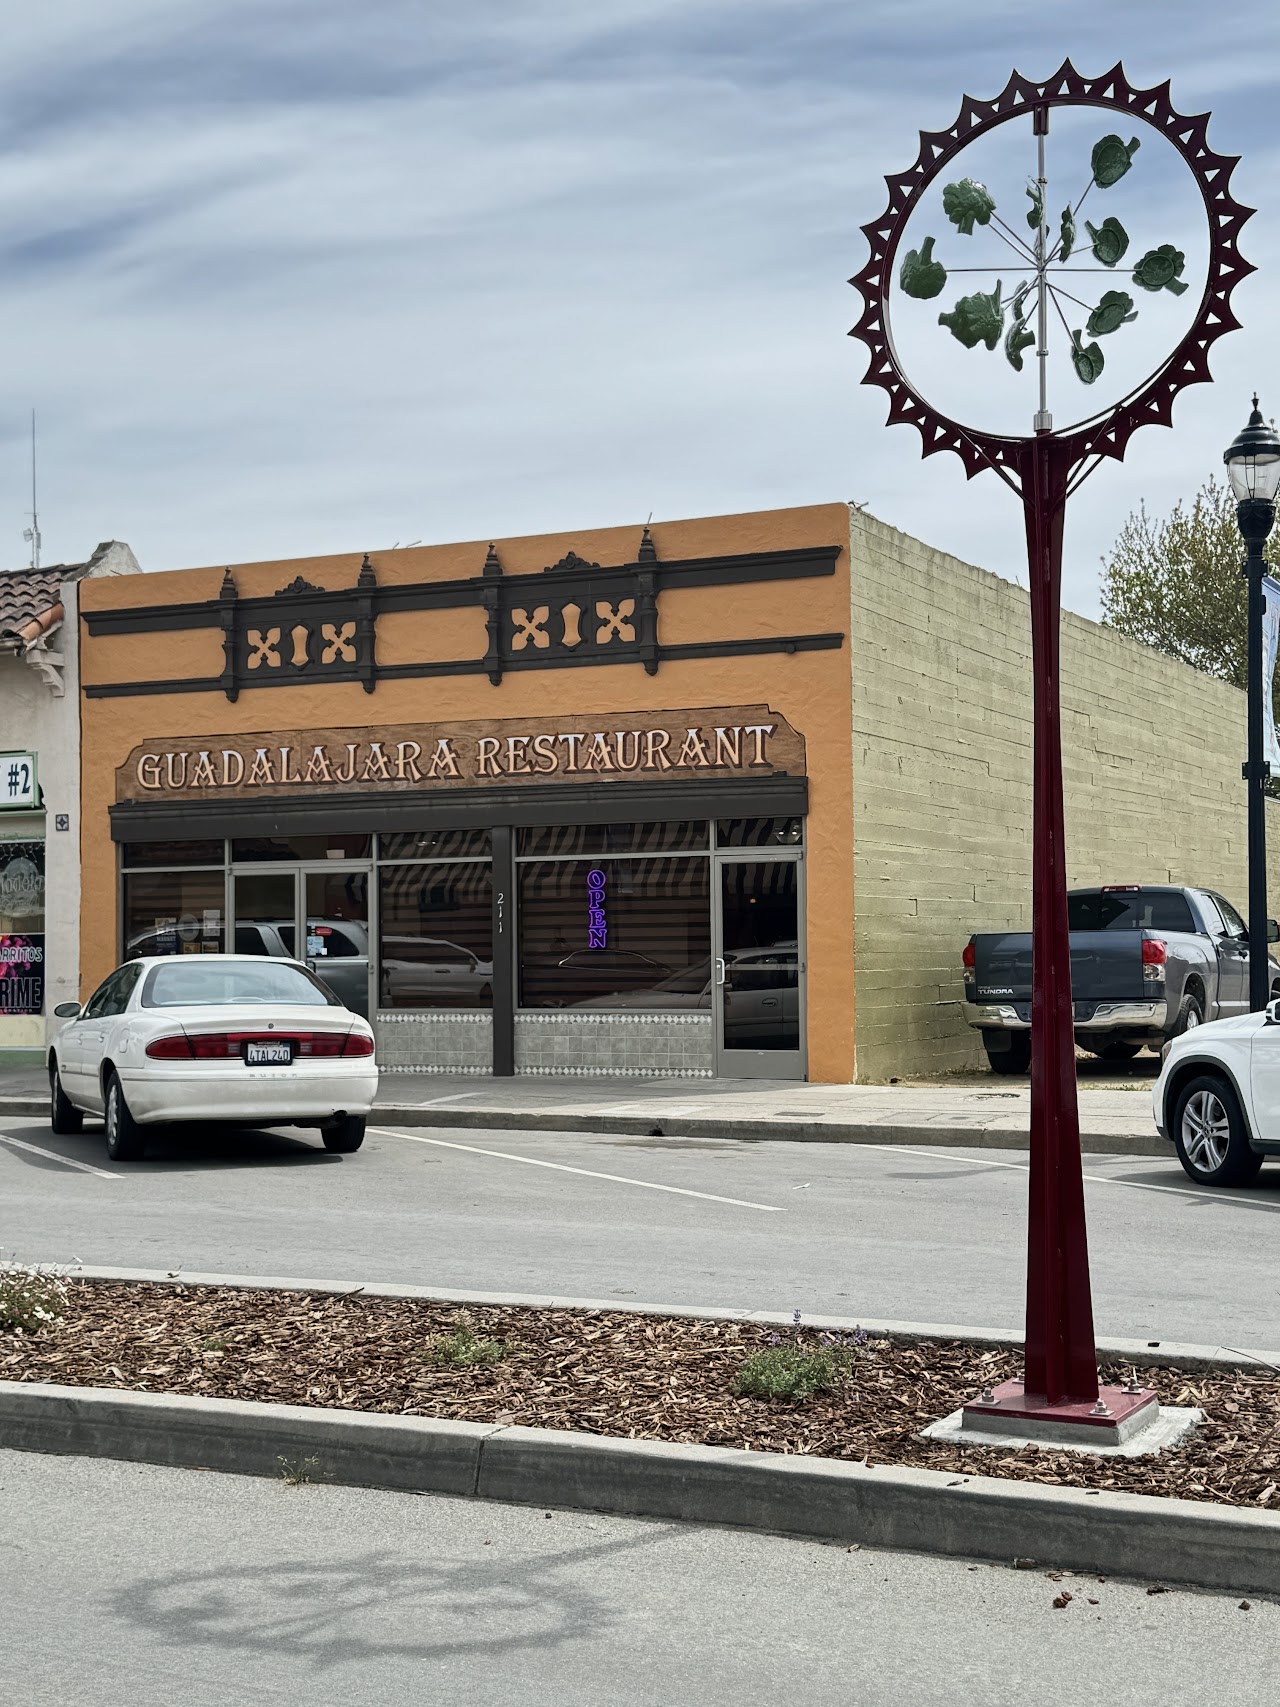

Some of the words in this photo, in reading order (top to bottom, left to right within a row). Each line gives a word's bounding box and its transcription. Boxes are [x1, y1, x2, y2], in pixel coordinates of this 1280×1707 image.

[137, 739, 462, 789] GUADALAJARA
[475, 725, 777, 778] RESTAURANT
[8, 763, 31, 797] #2
[586, 868, 607, 949] OPEN
[0, 946, 43, 962] RRITOS
[249, 1049, 289, 1062] 4TAL240
